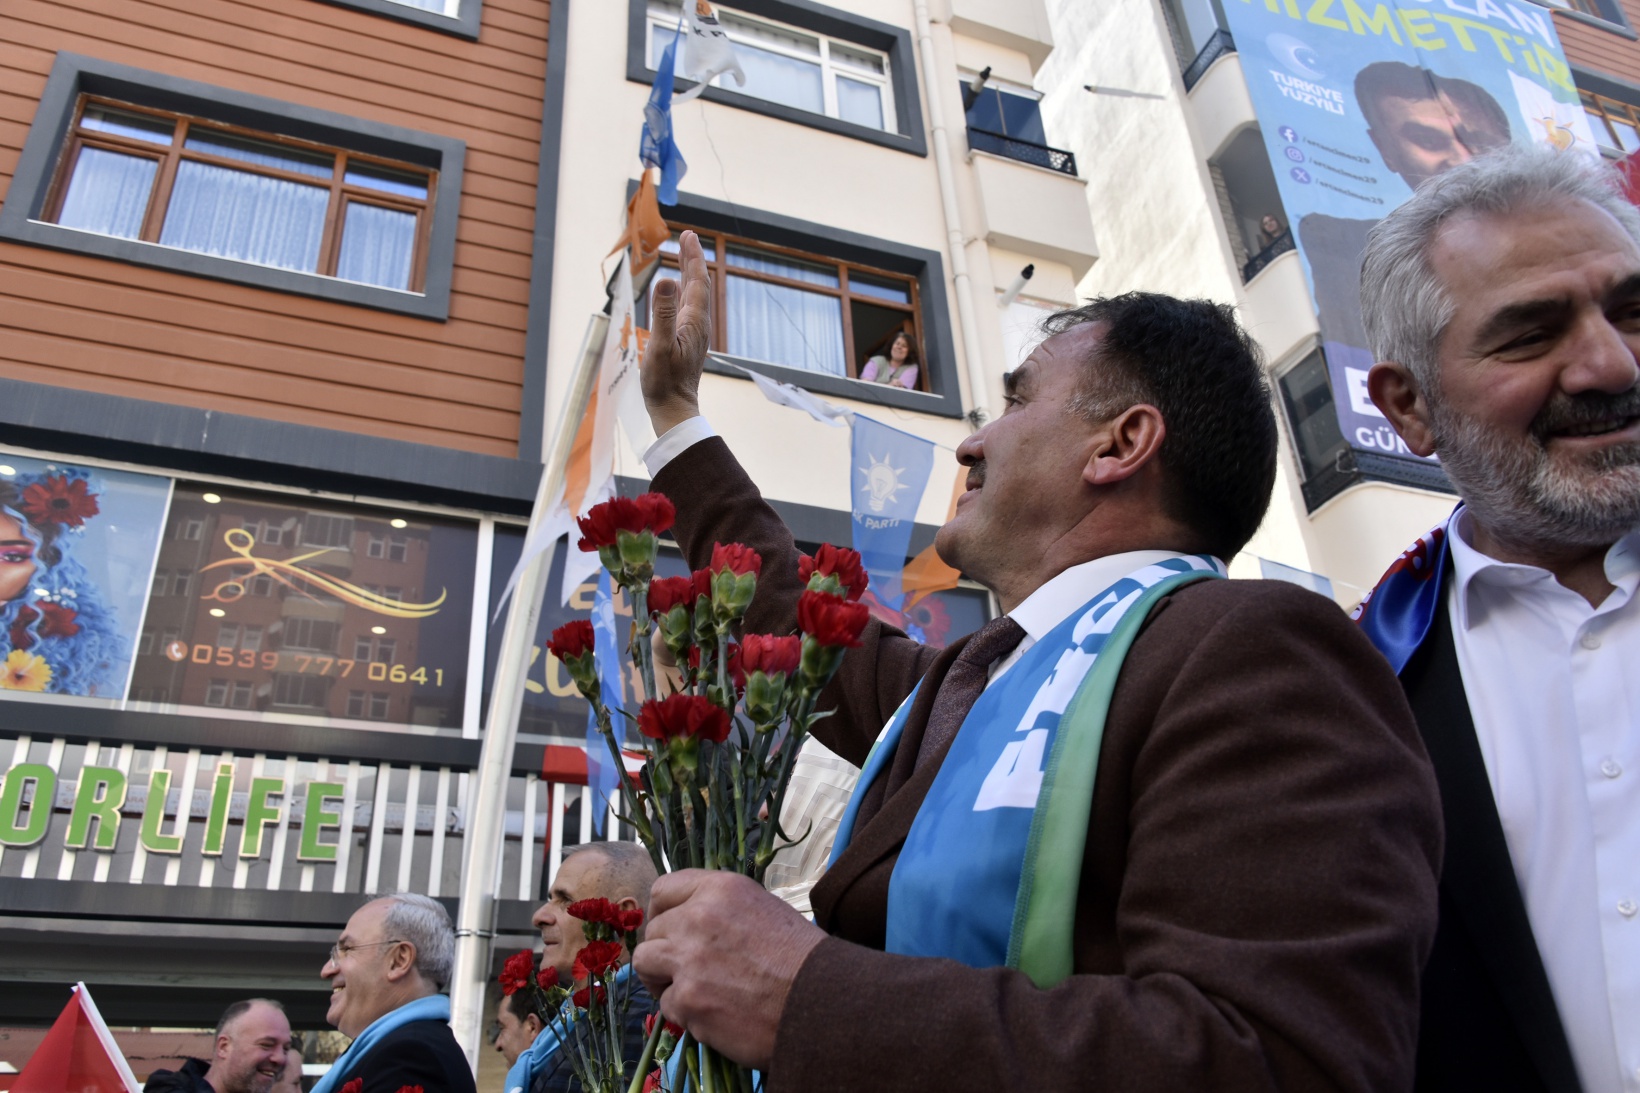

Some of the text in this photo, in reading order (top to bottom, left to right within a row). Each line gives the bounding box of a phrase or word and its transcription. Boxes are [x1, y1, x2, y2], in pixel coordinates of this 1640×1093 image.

[191, 644, 444, 687] 0539 777 0641
